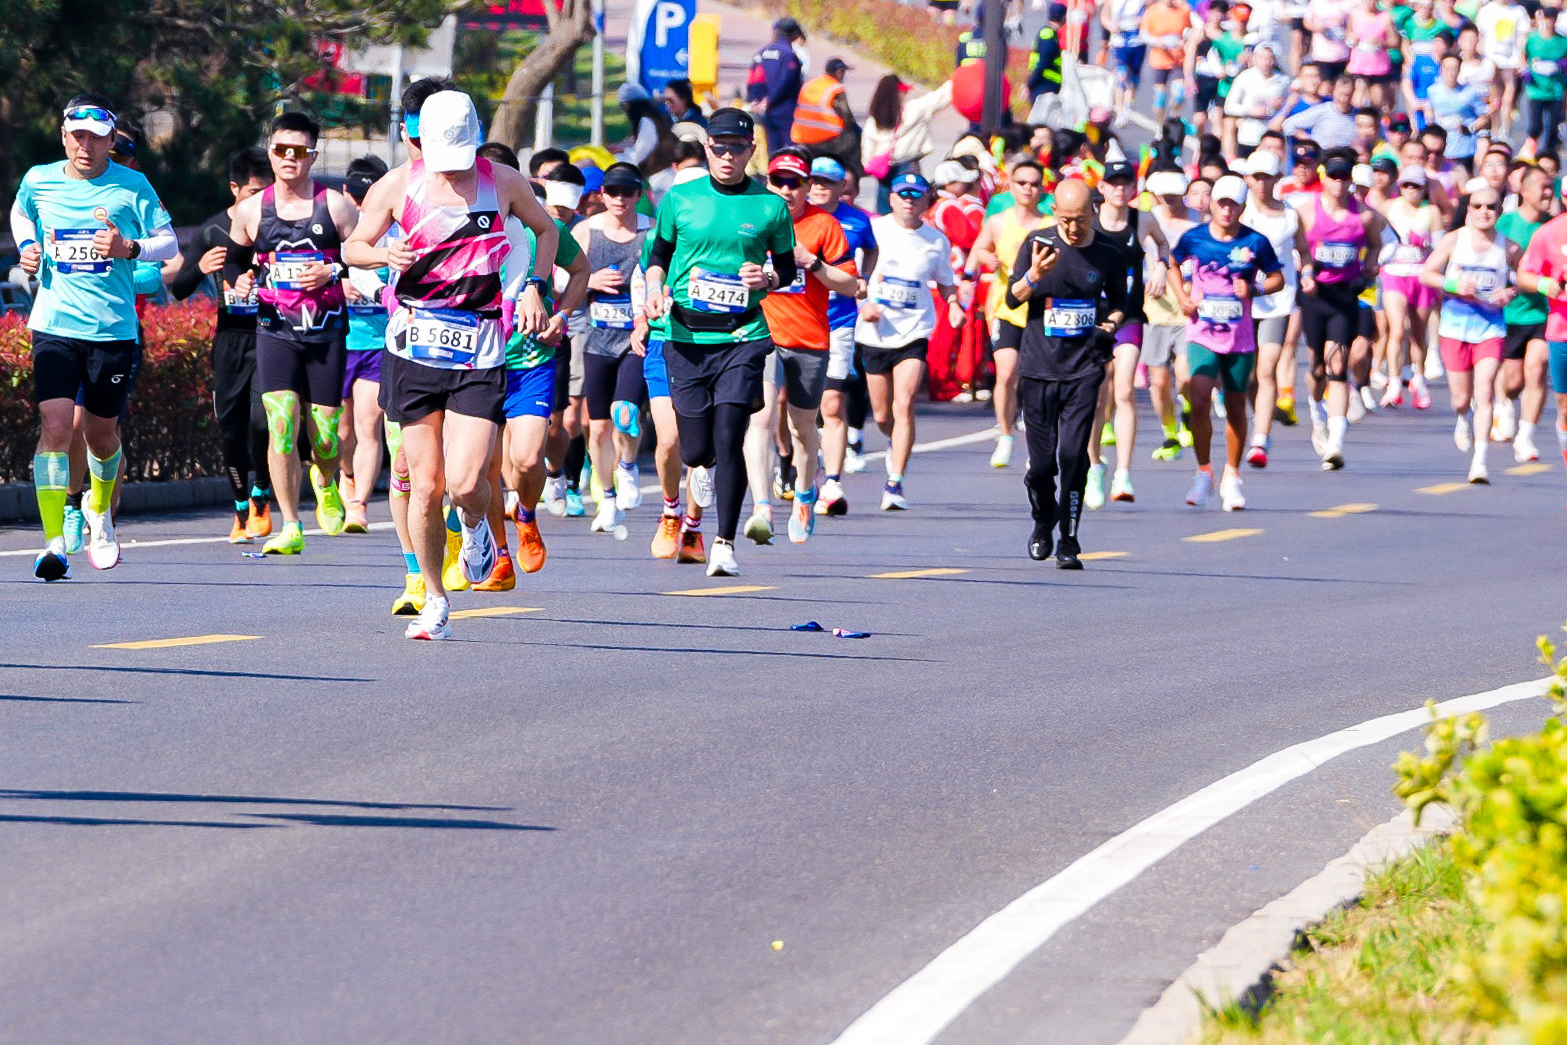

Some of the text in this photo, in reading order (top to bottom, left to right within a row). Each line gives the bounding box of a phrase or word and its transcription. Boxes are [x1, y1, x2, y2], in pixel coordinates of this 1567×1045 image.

[655, 1, 687, 48] P
[55, 246, 63, 261] A
[273, 267, 282, 280] A
[691, 285, 745, 305] A 2474
[1048, 313, 1057, 325] A
[409, 326, 473, 350] B 5681
